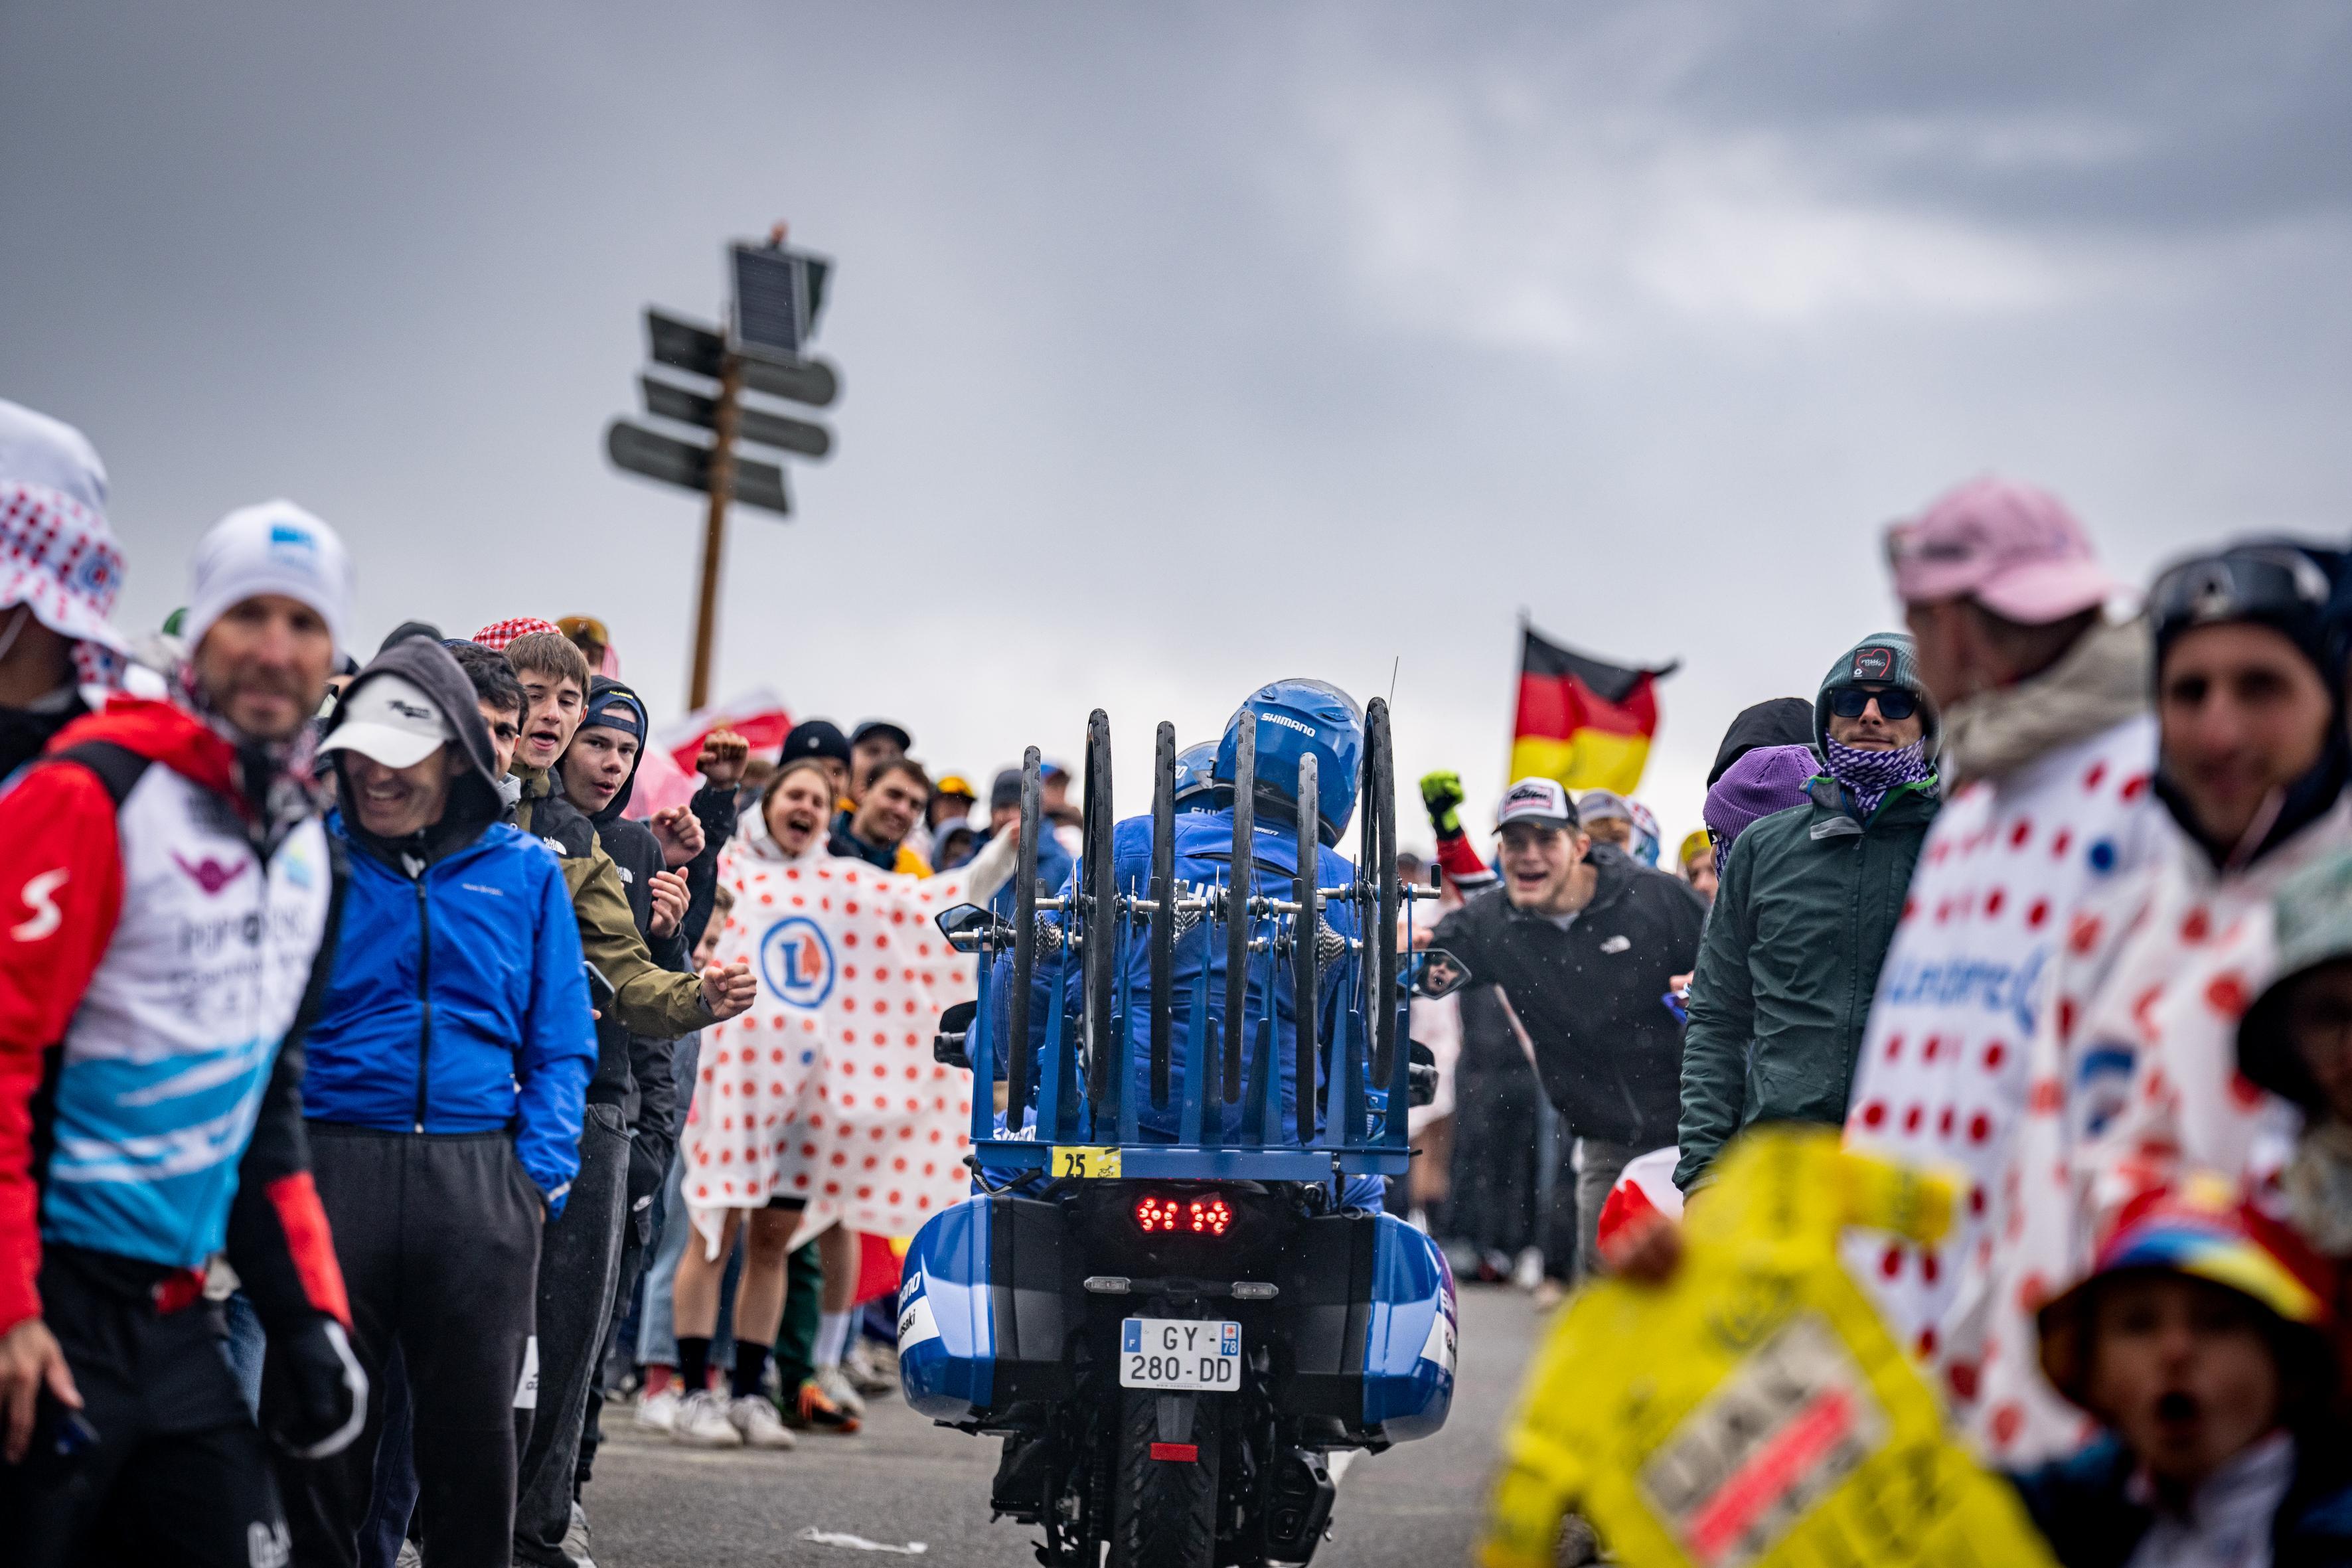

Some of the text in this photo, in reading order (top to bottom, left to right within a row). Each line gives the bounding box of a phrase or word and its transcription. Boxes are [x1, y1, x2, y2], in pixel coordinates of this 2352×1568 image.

[1261, 712, 1316, 738] SHIMANO
[1065, 1153, 1085, 1178] 25
[1129, 1339, 1136, 1348] F
[1223, 1340, 1237, 1354] 78
